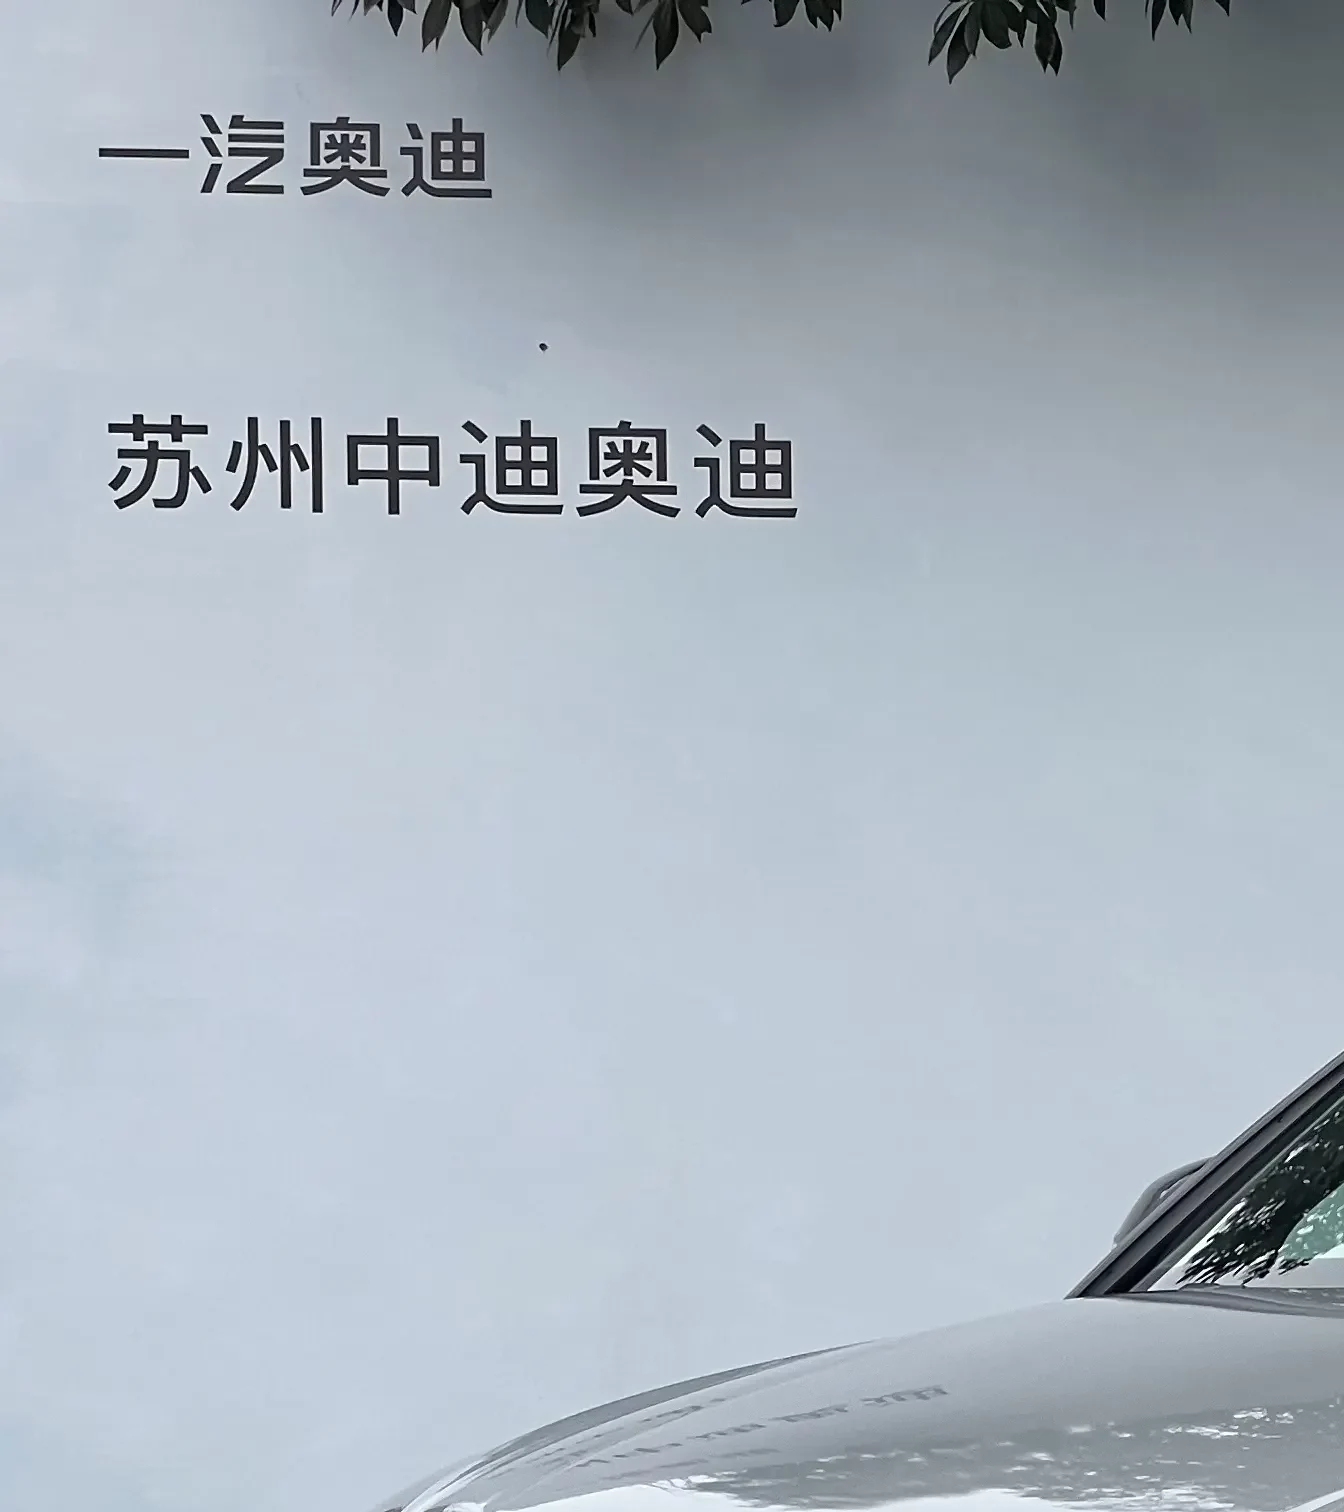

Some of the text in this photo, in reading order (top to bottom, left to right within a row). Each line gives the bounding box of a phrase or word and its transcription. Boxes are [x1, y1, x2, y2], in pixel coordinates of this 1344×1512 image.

[99, 114, 493, 199] 一汽奥迪
[107, 413, 799, 519] 苏州中迪奥迪
